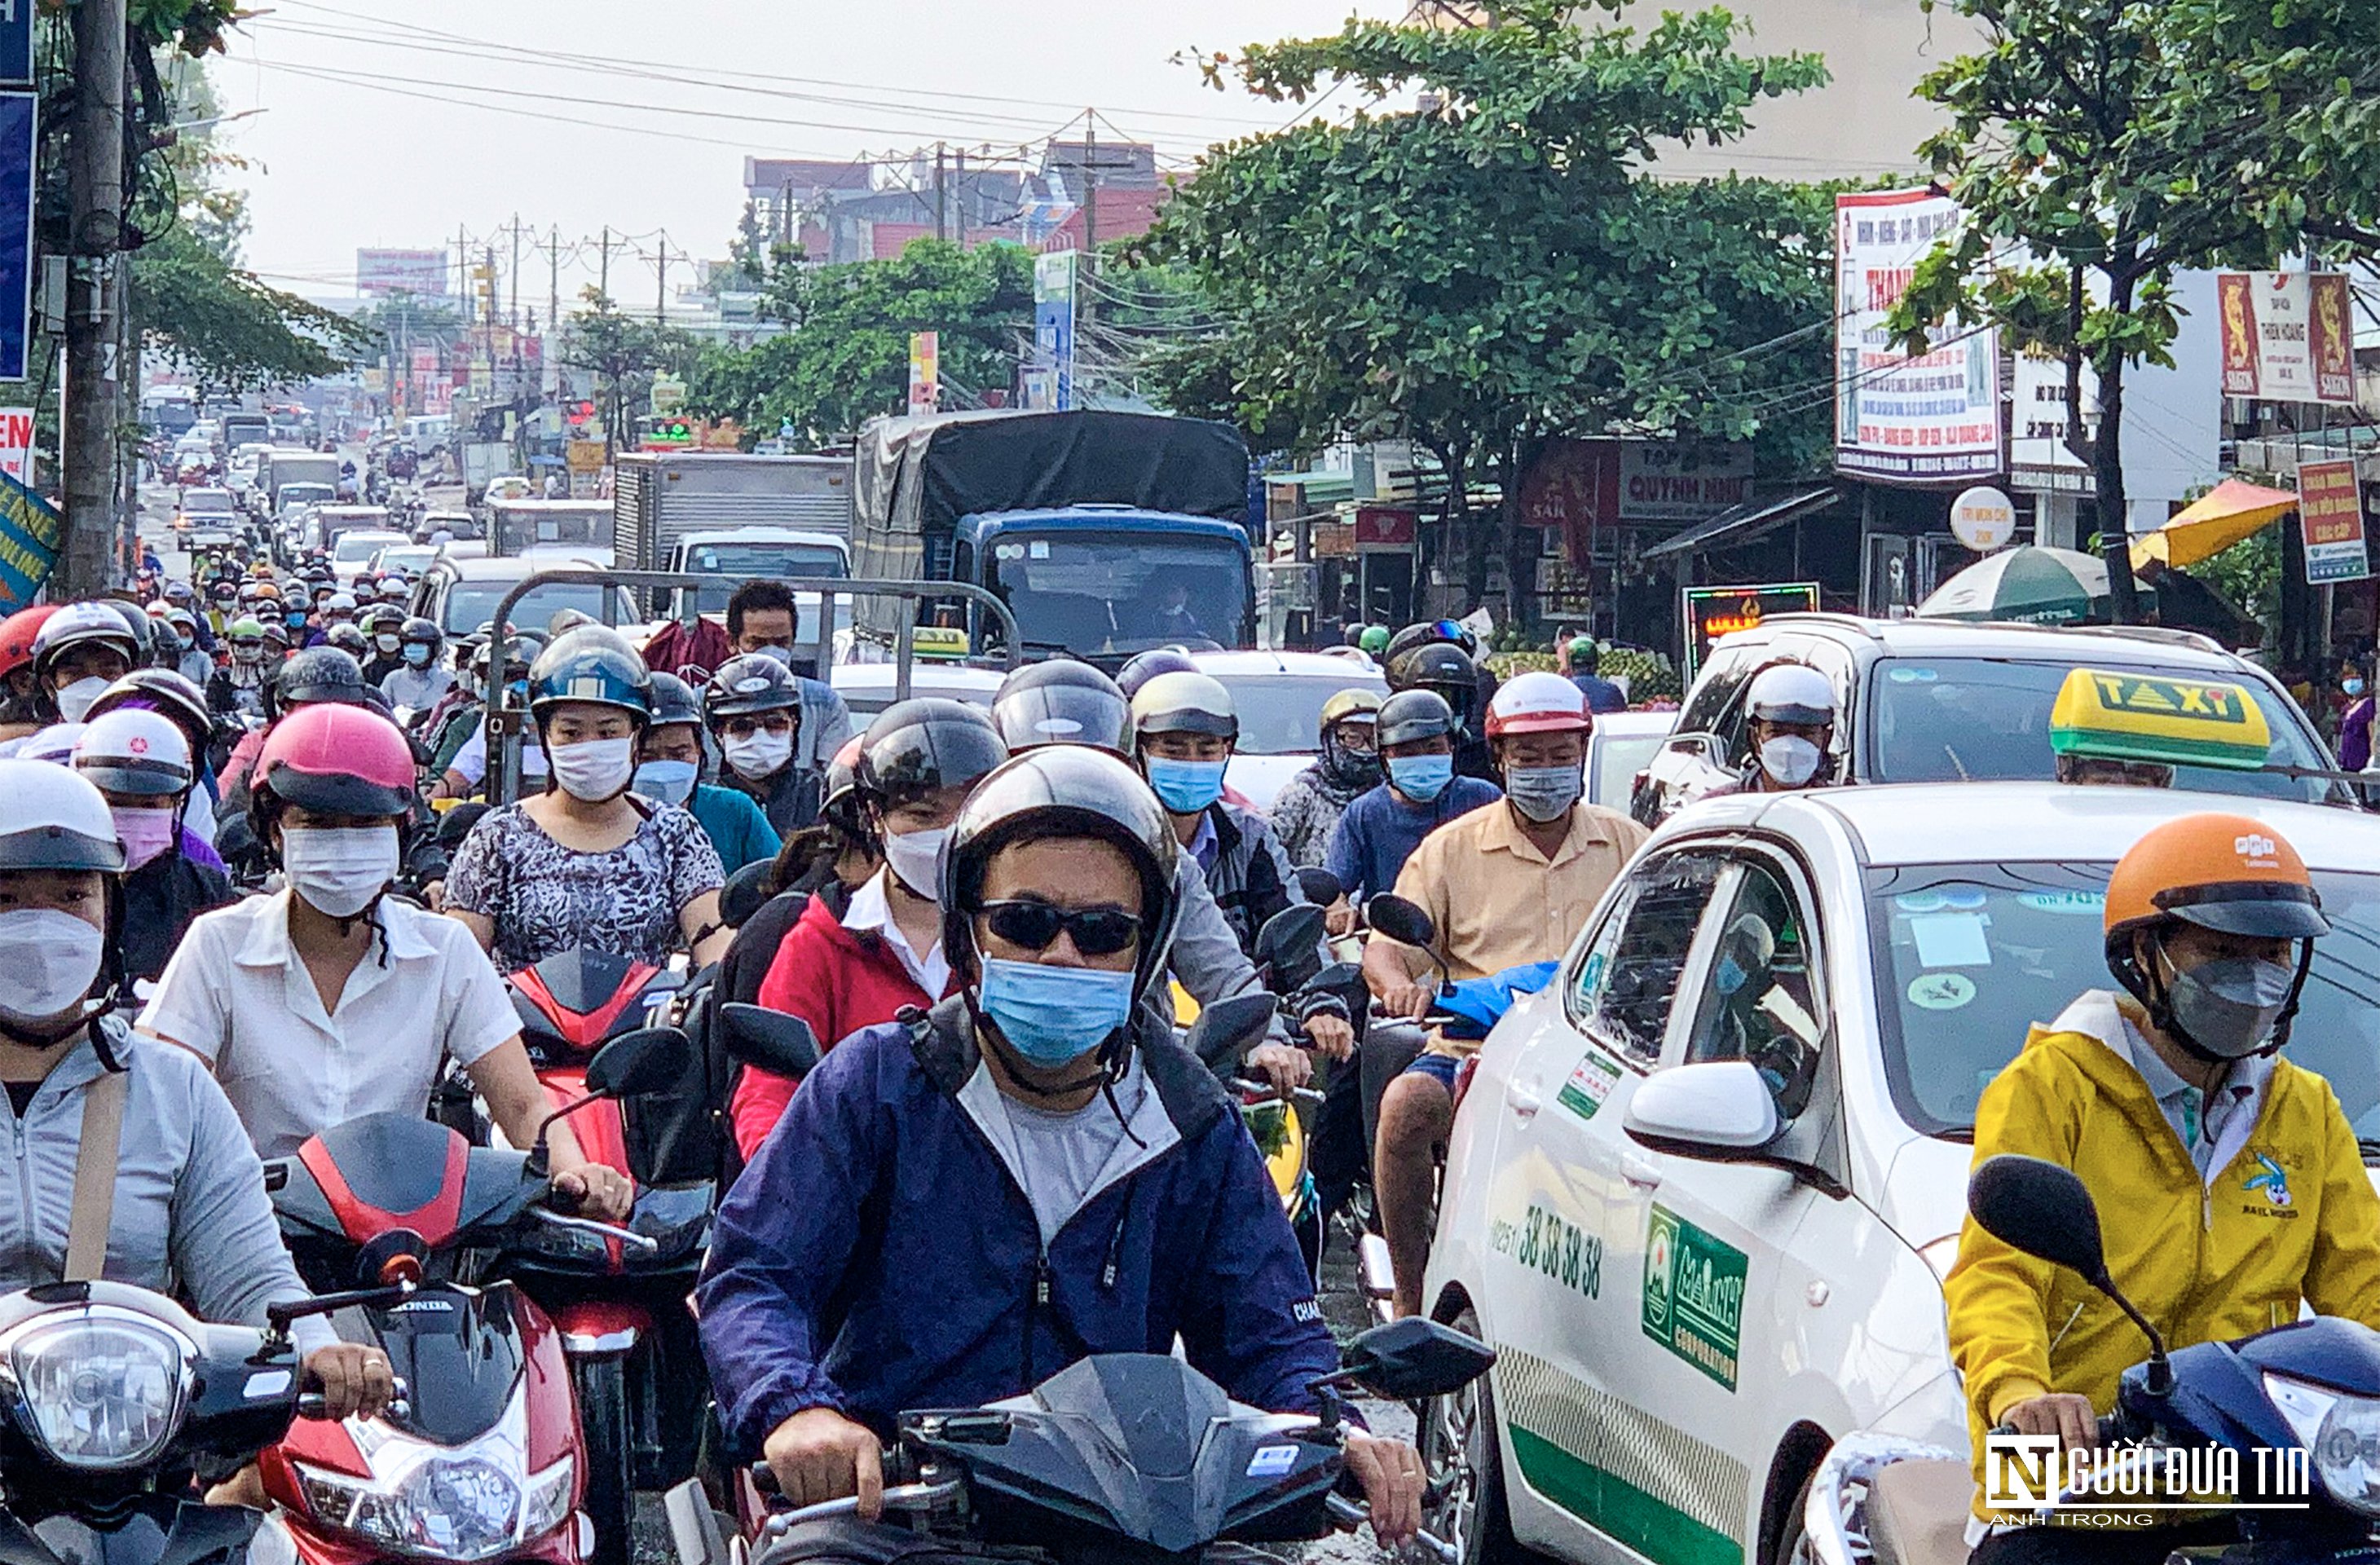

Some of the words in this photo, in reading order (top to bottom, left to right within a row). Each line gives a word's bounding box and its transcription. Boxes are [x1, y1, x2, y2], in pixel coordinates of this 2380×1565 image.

[2096, 676, 2231, 716] TAXI
[1520, 1206, 1542, 1267] 38
[1542, 1214, 1562, 1277] 38
[1562, 1225, 1581, 1289] 38
[1583, 1235, 1602, 1300] 38
